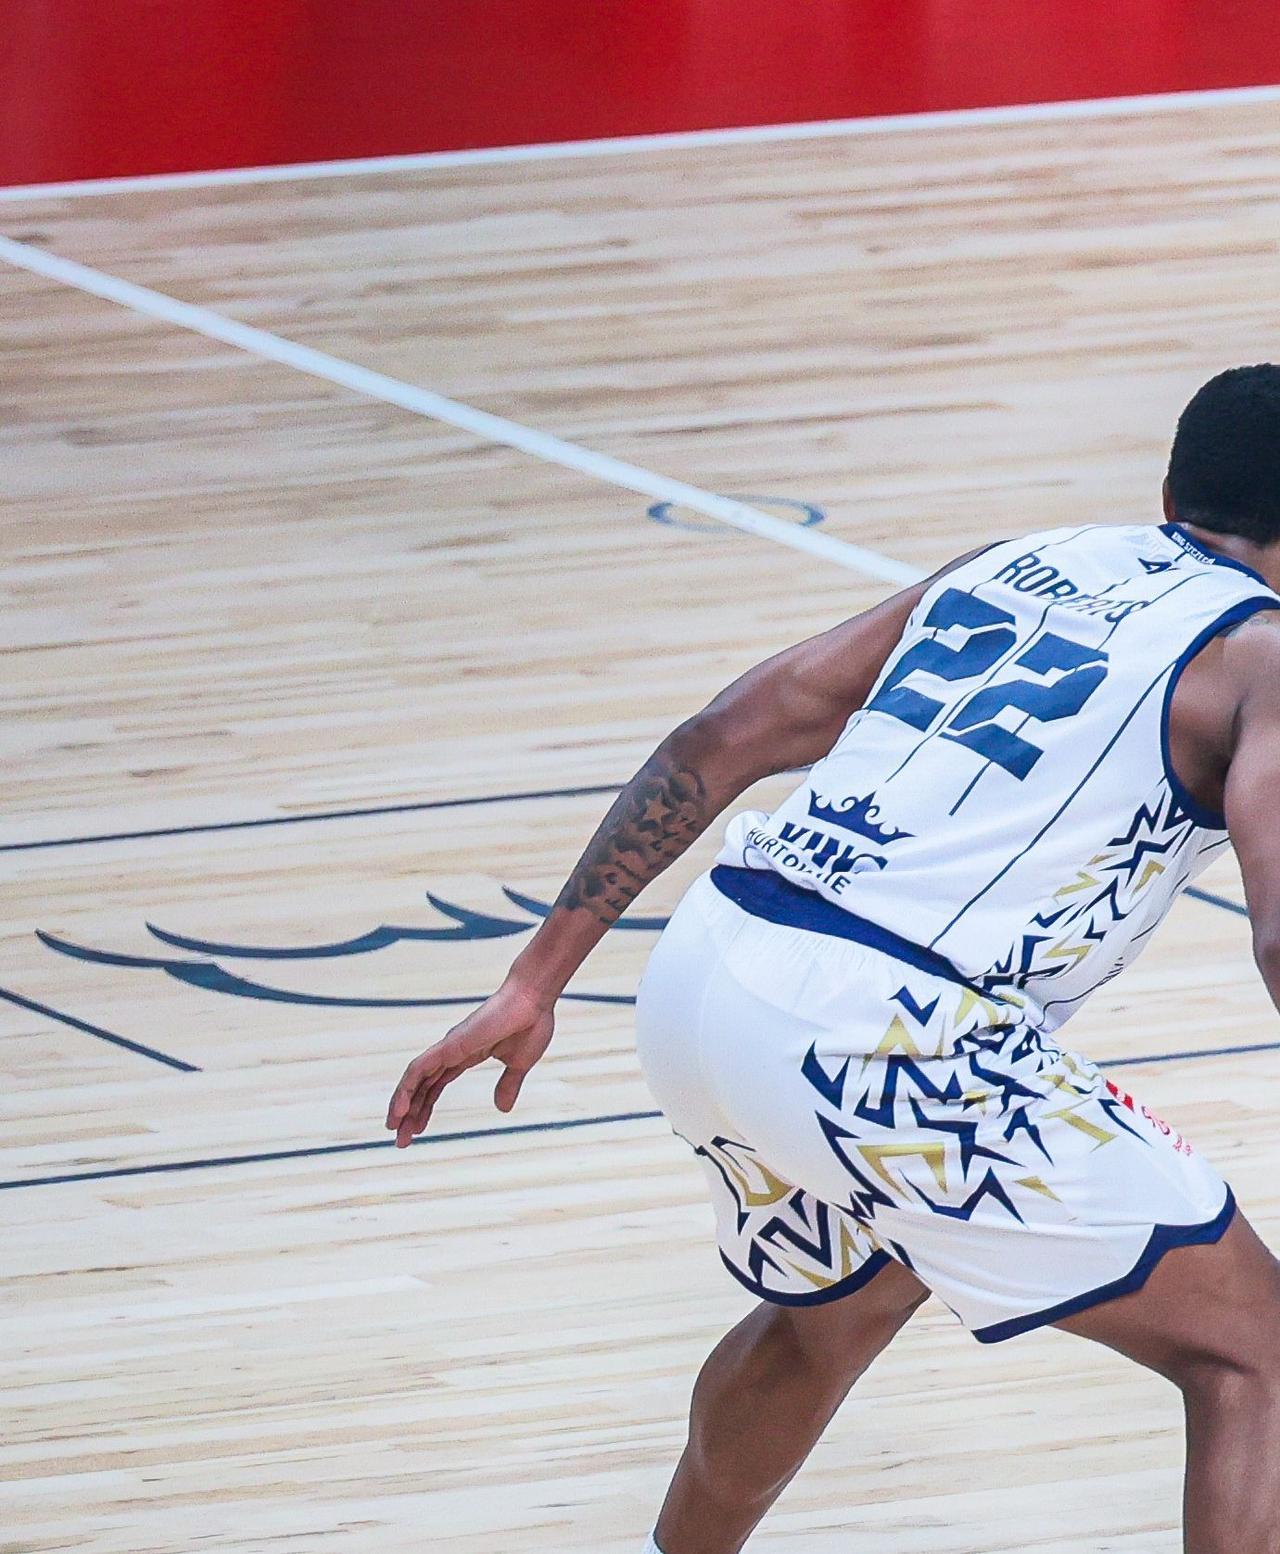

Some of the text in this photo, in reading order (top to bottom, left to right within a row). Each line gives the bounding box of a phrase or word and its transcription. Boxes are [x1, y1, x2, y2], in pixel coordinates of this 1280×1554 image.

[992, 551, 1152, 623] ROBERTS
[868, 587, 1109, 782] 22
[747, 828, 851, 895] HURTOIE
